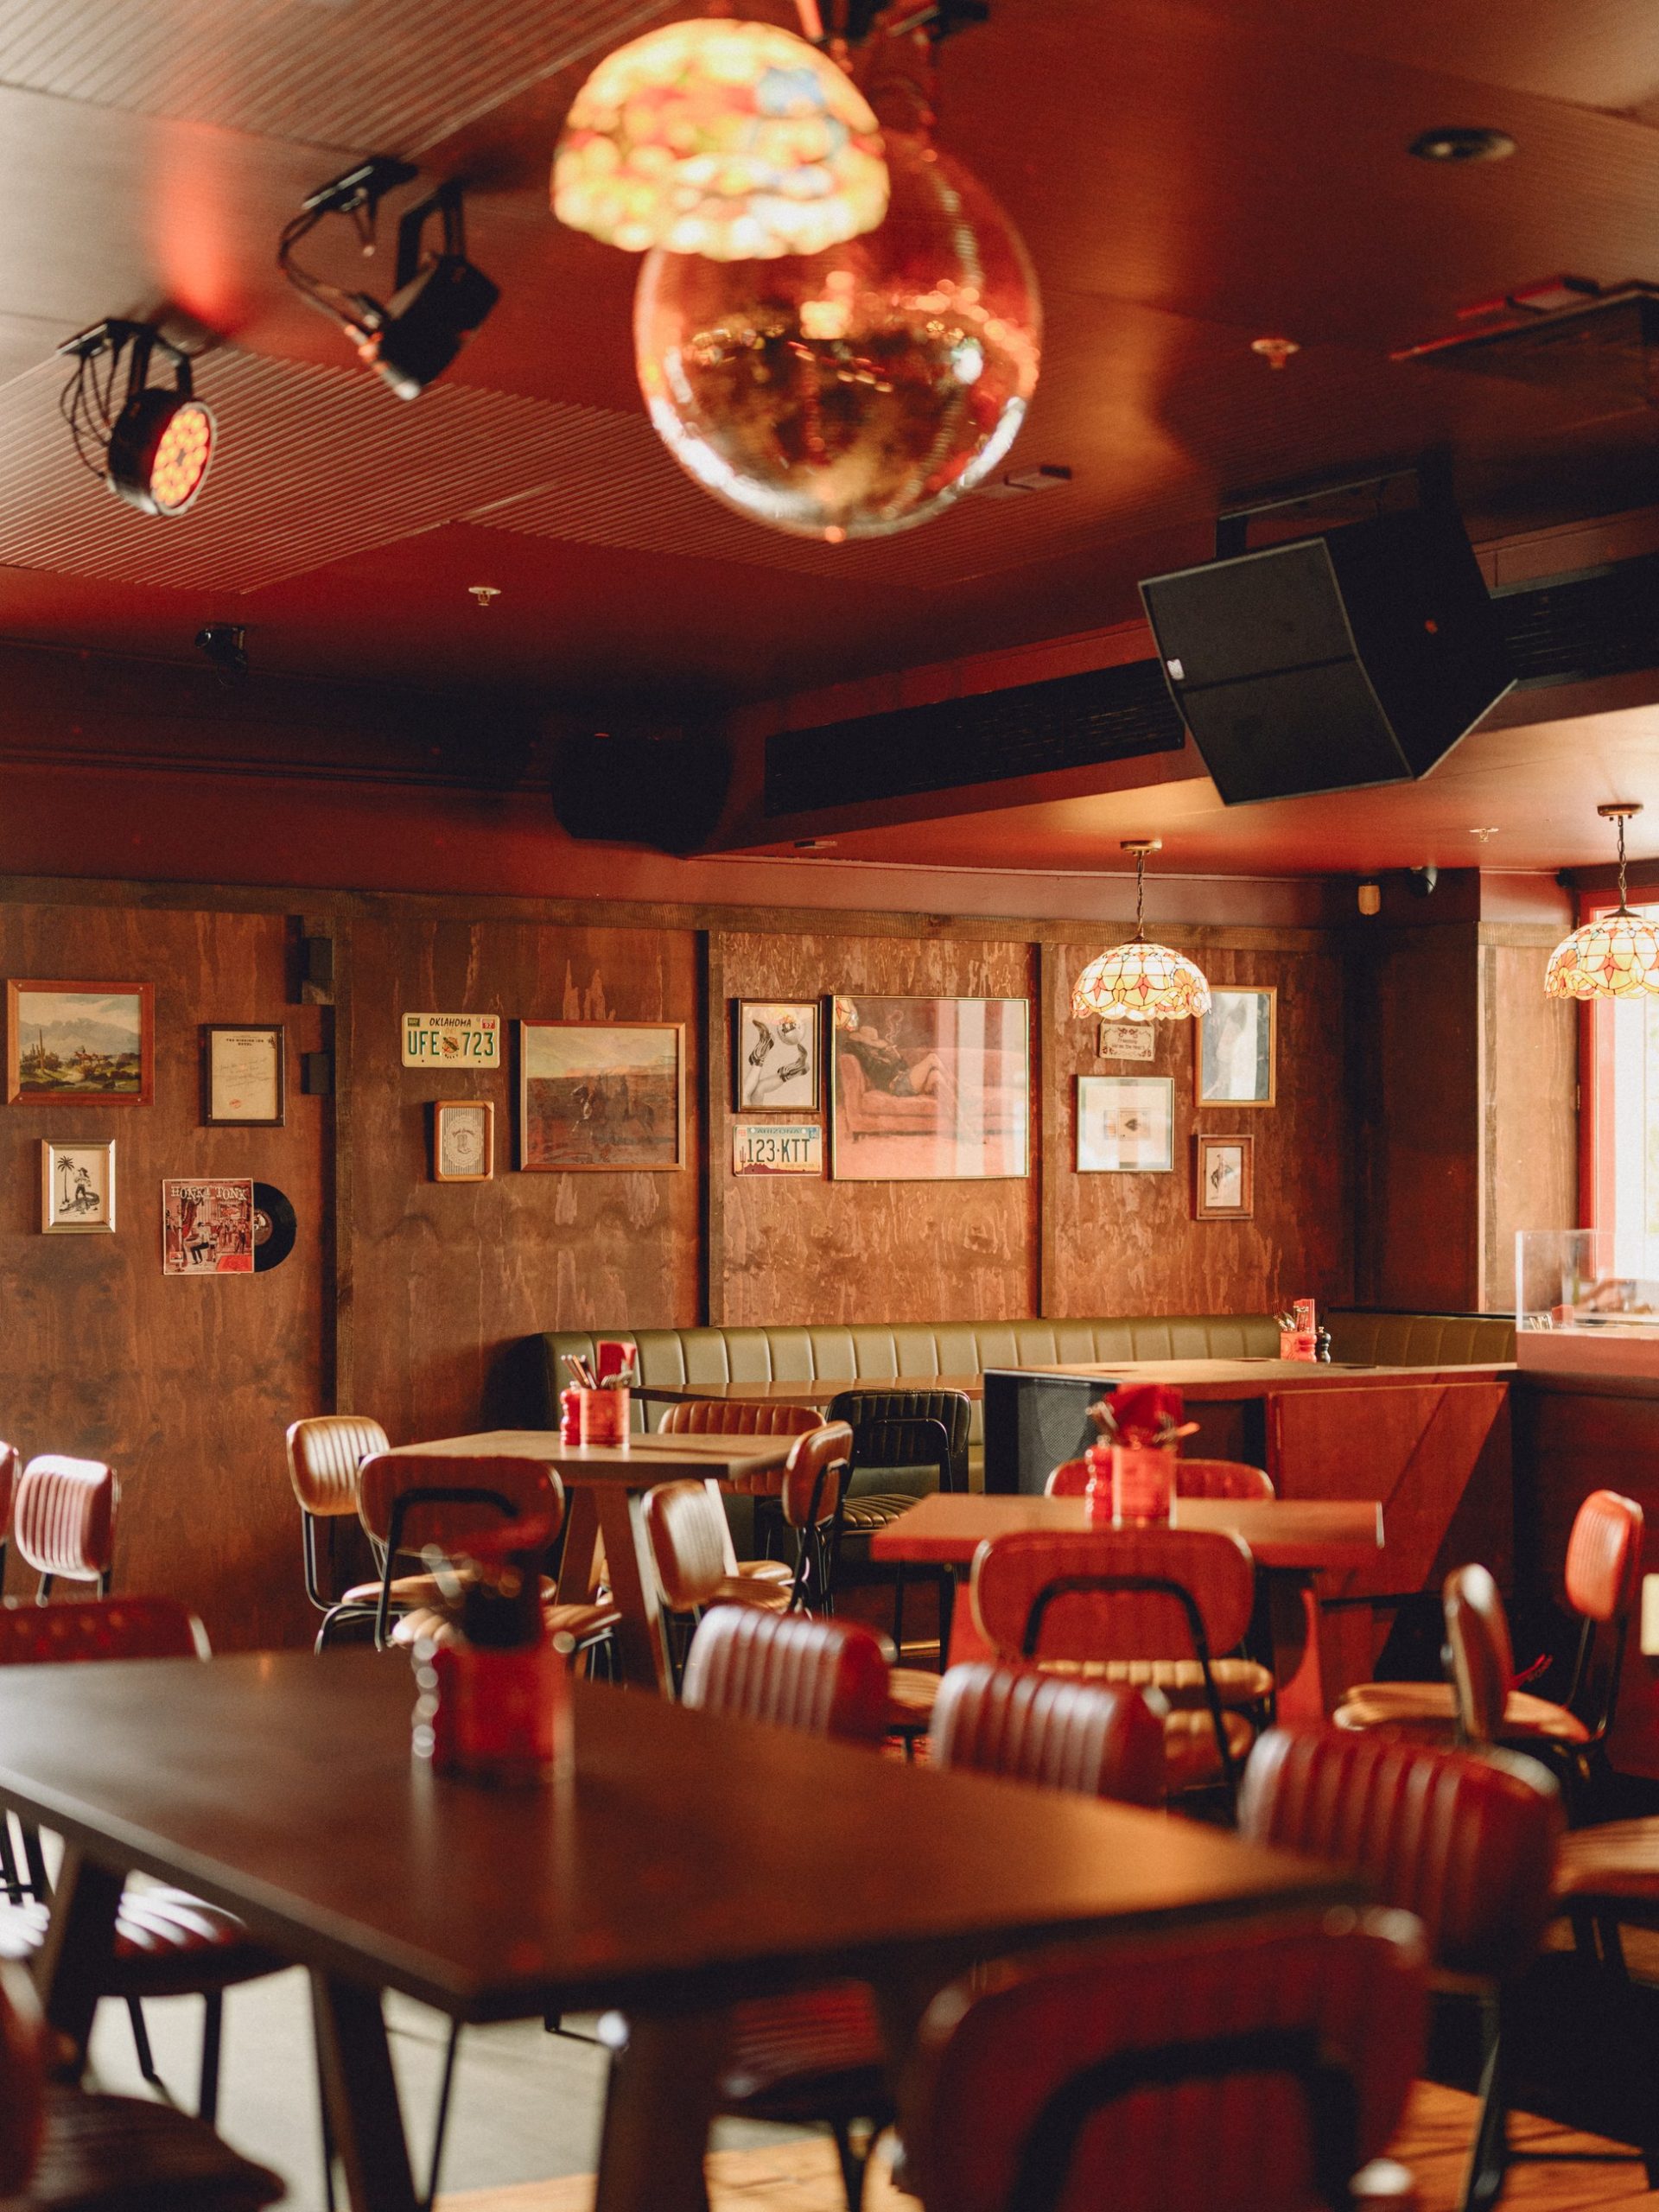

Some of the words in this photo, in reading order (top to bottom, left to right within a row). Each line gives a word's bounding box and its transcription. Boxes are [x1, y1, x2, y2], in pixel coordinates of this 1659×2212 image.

[429, 1017, 472, 1027] OKLAHOMA
[408, 1031, 440, 1055] UFE
[461, 1032, 493, 1056] 723
[170, 1185, 213, 1200] HONKY
[214, 1186, 248, 1201] TONK
